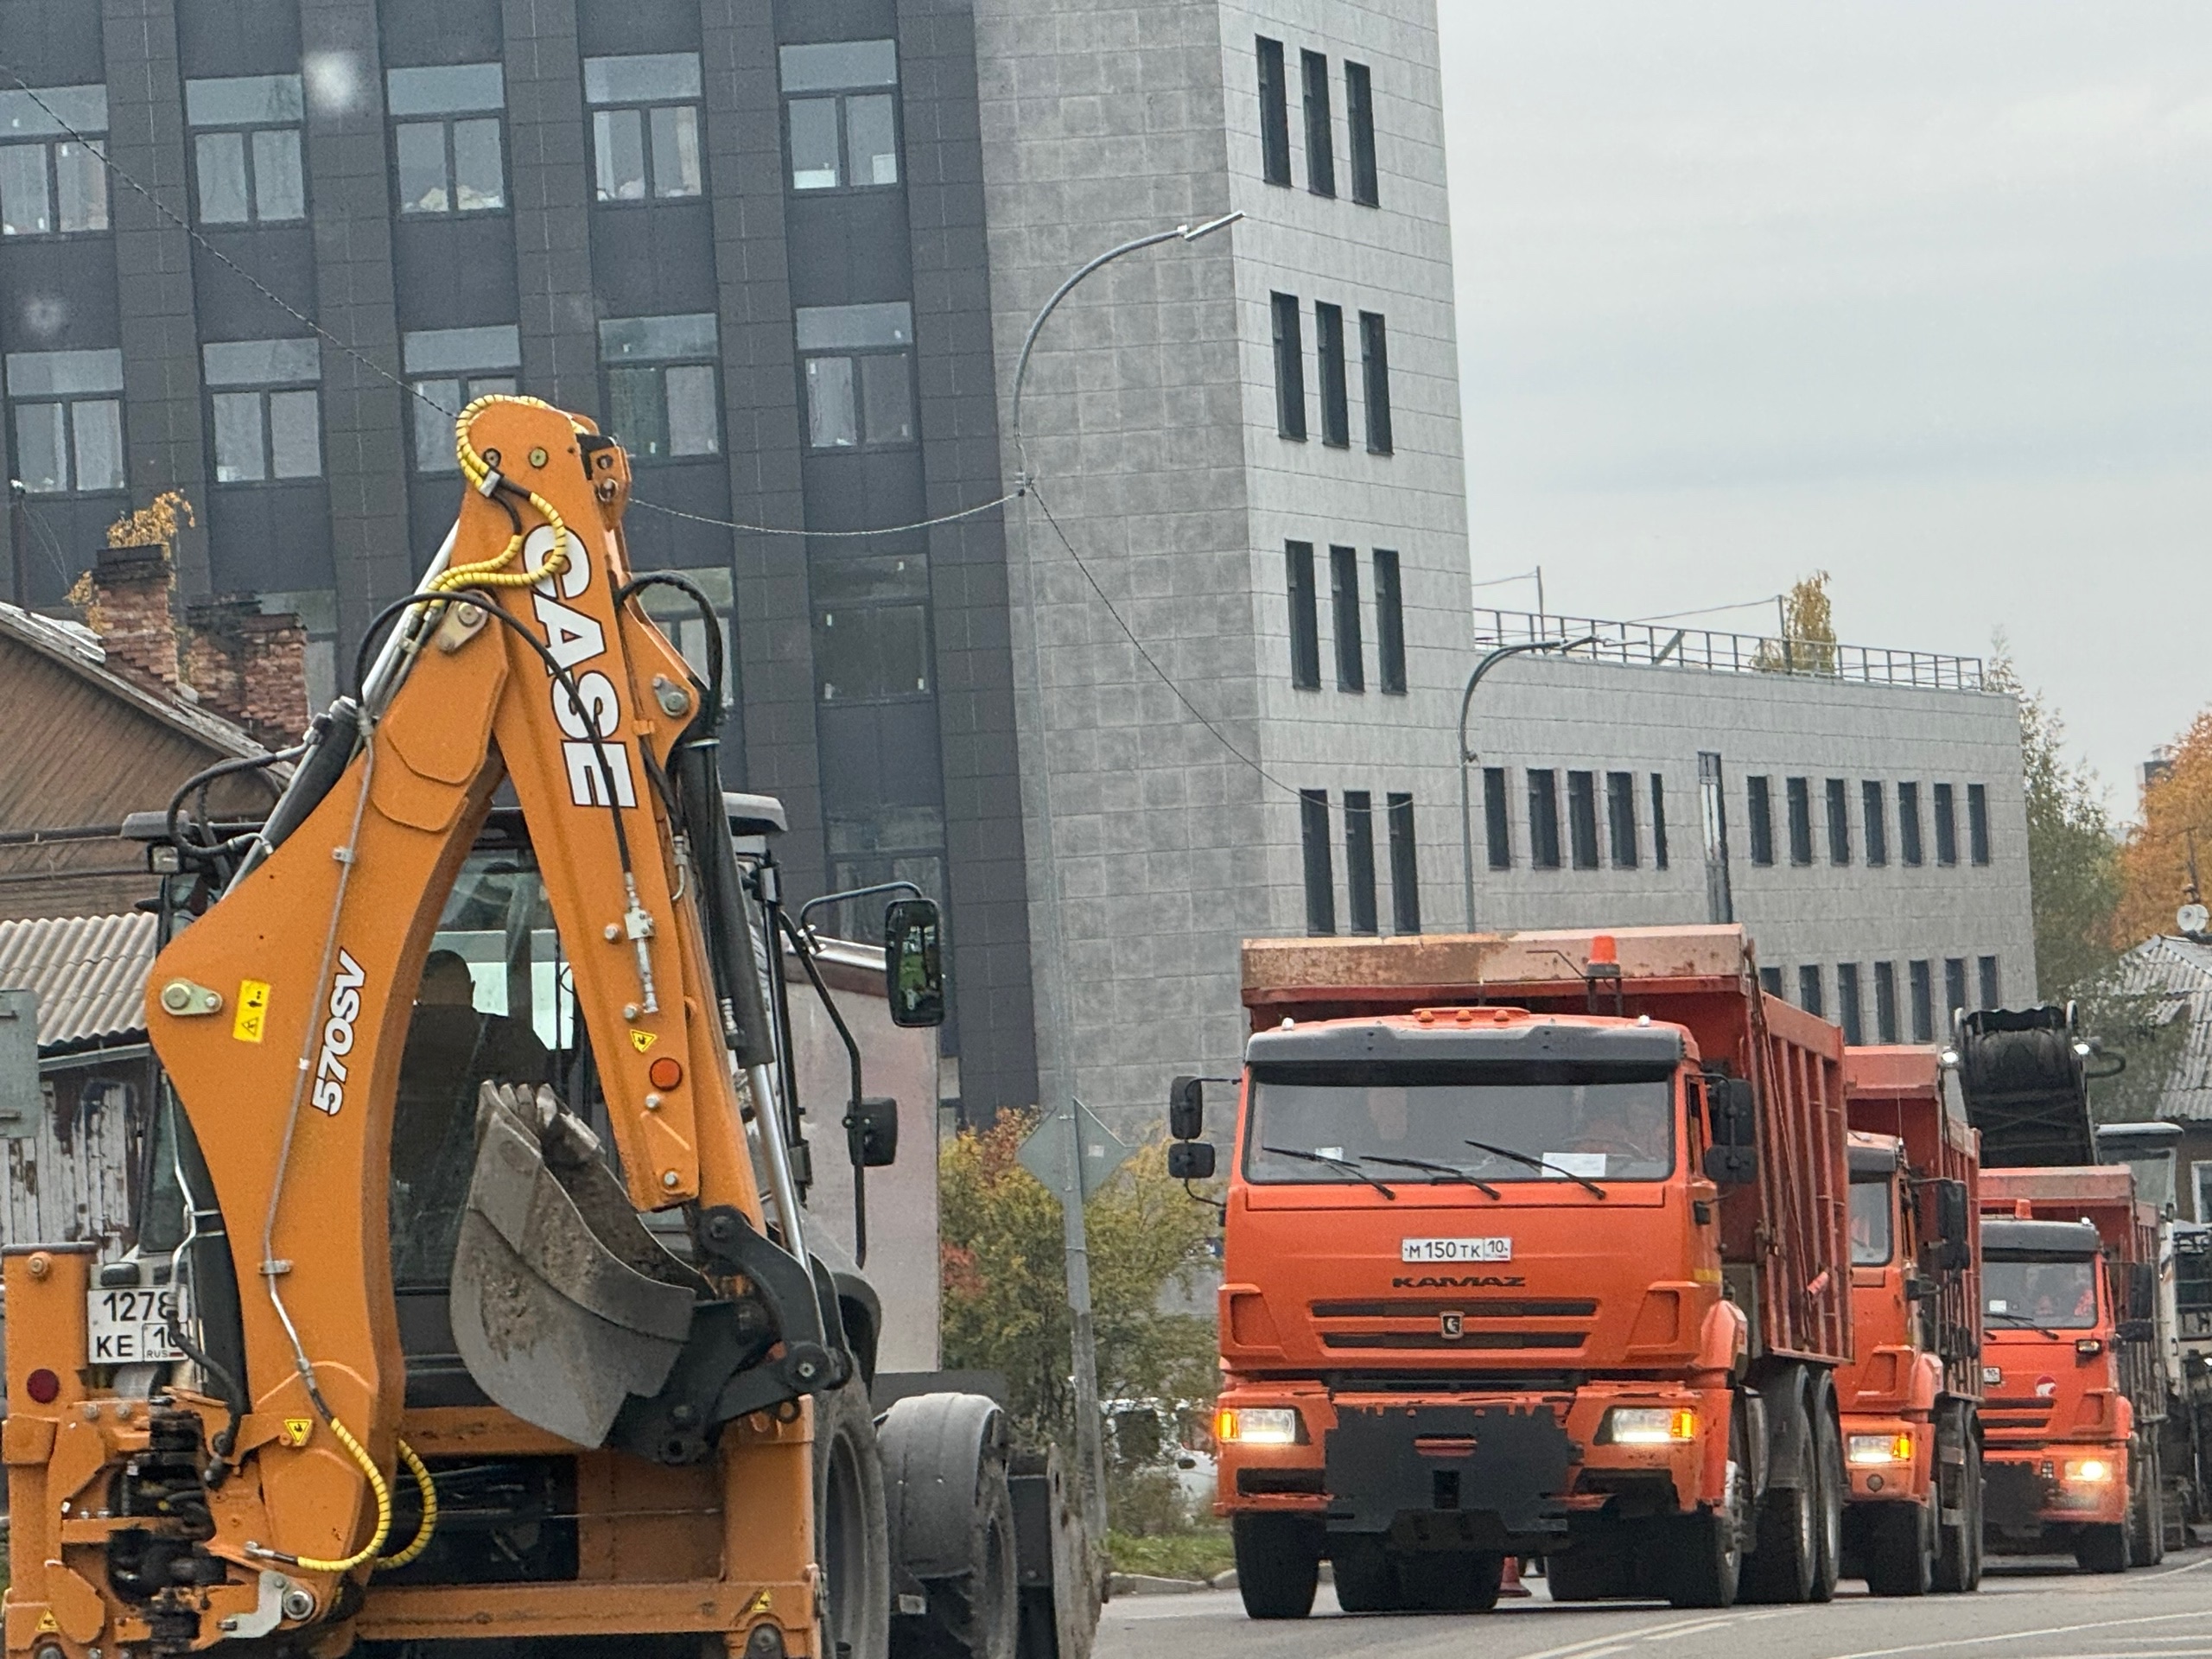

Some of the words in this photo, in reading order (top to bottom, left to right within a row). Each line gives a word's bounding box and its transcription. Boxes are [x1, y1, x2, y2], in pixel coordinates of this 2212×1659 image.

[522, 523, 638, 808] CASE
[310, 946, 365, 1116] 570SV
[1487, 1239, 1504, 1253] 10
[1392, 1276, 1526, 1288] KAMAZ
[102, 1291, 177, 1322] 1278
[96, 1335, 134, 1358] КЕ
[146, 1350, 168, 1358] RUS
